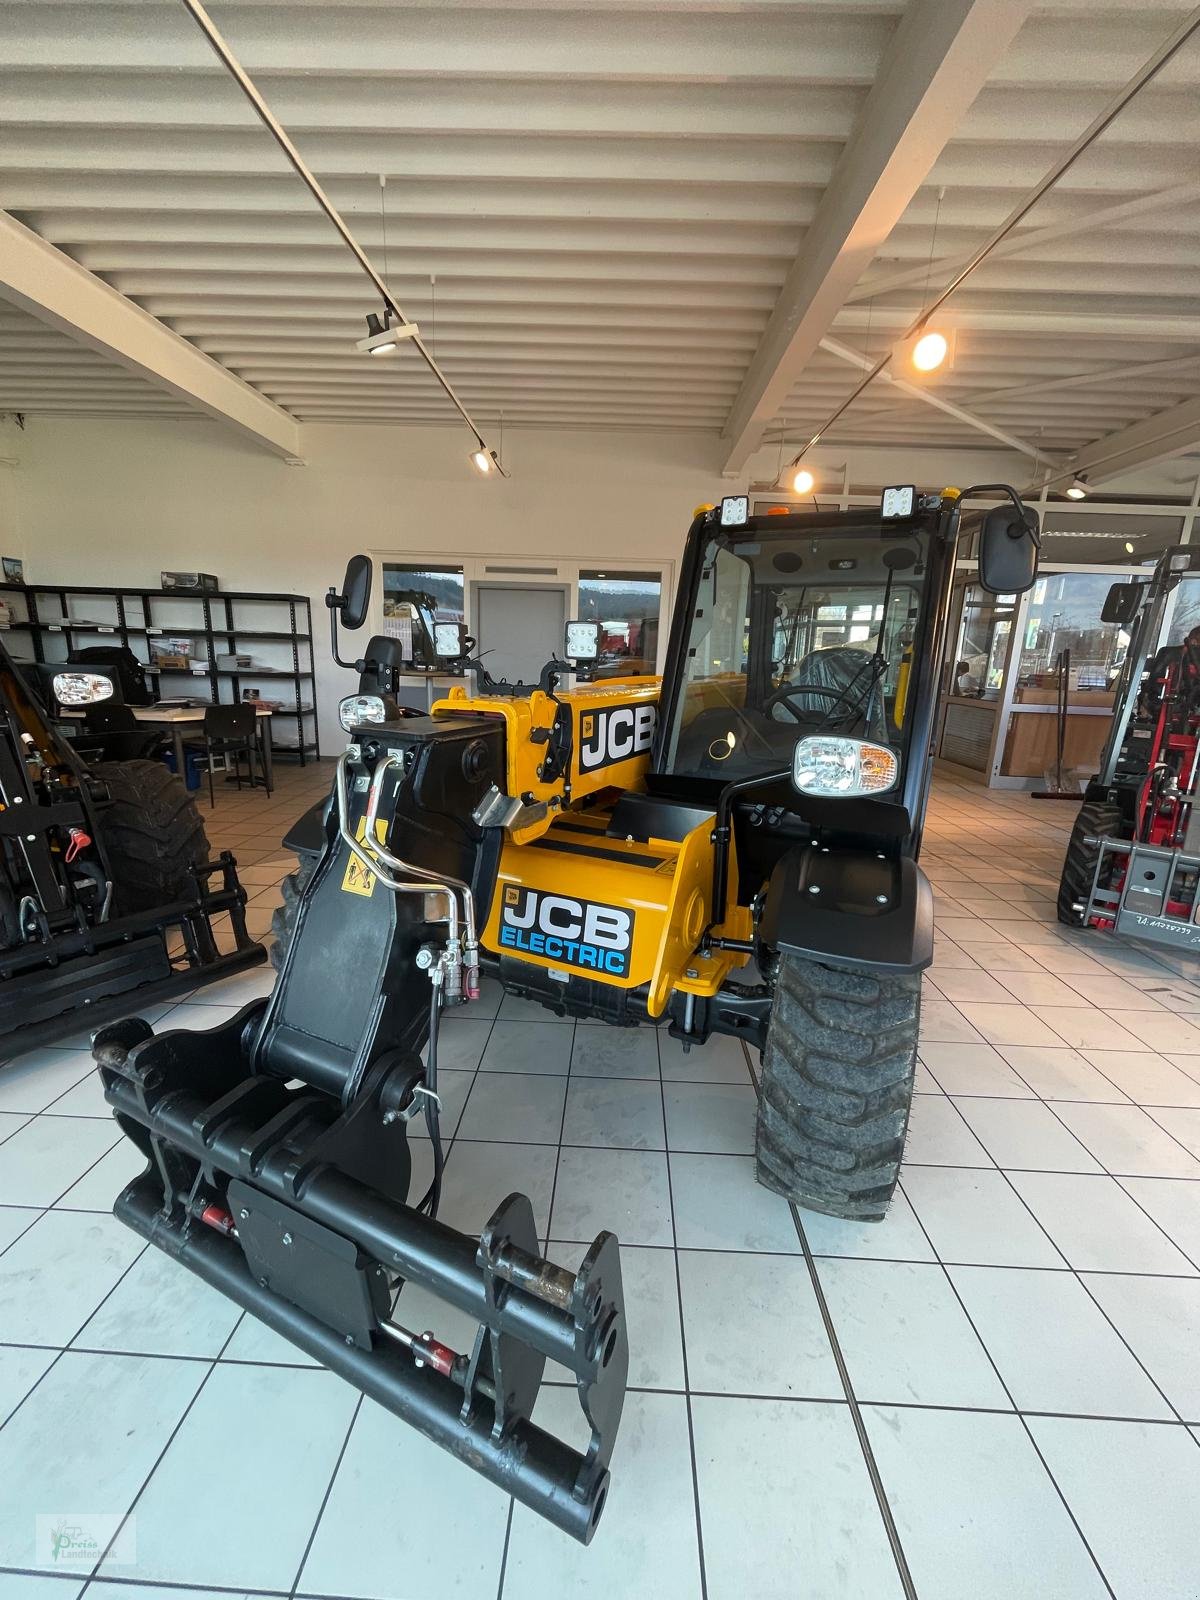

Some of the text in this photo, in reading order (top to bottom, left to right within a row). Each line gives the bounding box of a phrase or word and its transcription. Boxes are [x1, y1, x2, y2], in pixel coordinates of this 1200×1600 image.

[582, 705, 656, 767] JCB
[501, 925, 625, 973] ELECTRIC
[503, 891, 630, 951] JCB
